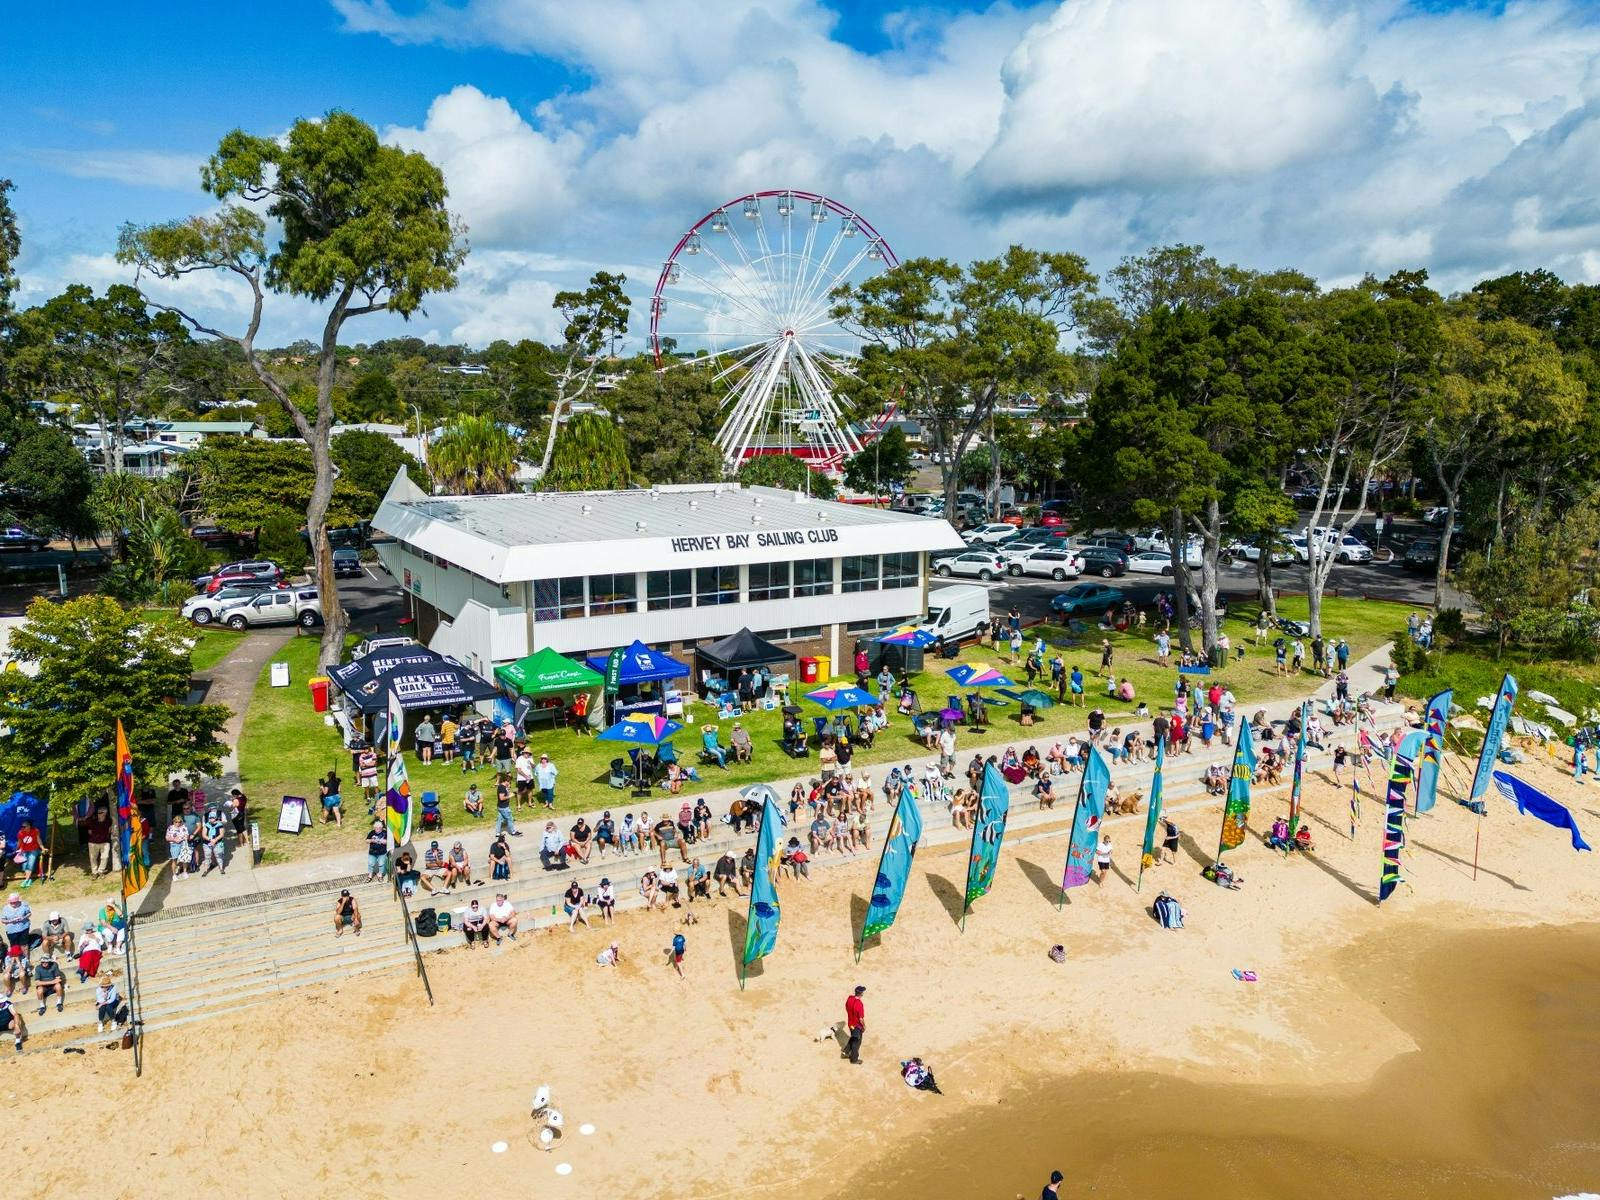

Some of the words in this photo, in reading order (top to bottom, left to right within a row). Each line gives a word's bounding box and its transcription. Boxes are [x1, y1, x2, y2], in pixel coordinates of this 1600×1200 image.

[671, 536, 721, 553] HERVEY
[726, 534, 750, 549] BAY
[757, 531, 805, 547] SAILING
[807, 529, 839, 543] CLUB
[372, 658, 401, 667] MEN'S
[612, 658, 620, 668] AID
[393, 675, 424, 685] MEN'S
[429, 674, 454, 684] TALK
[610, 669, 618, 684] FIRST
[399, 683, 427, 693] WALK
